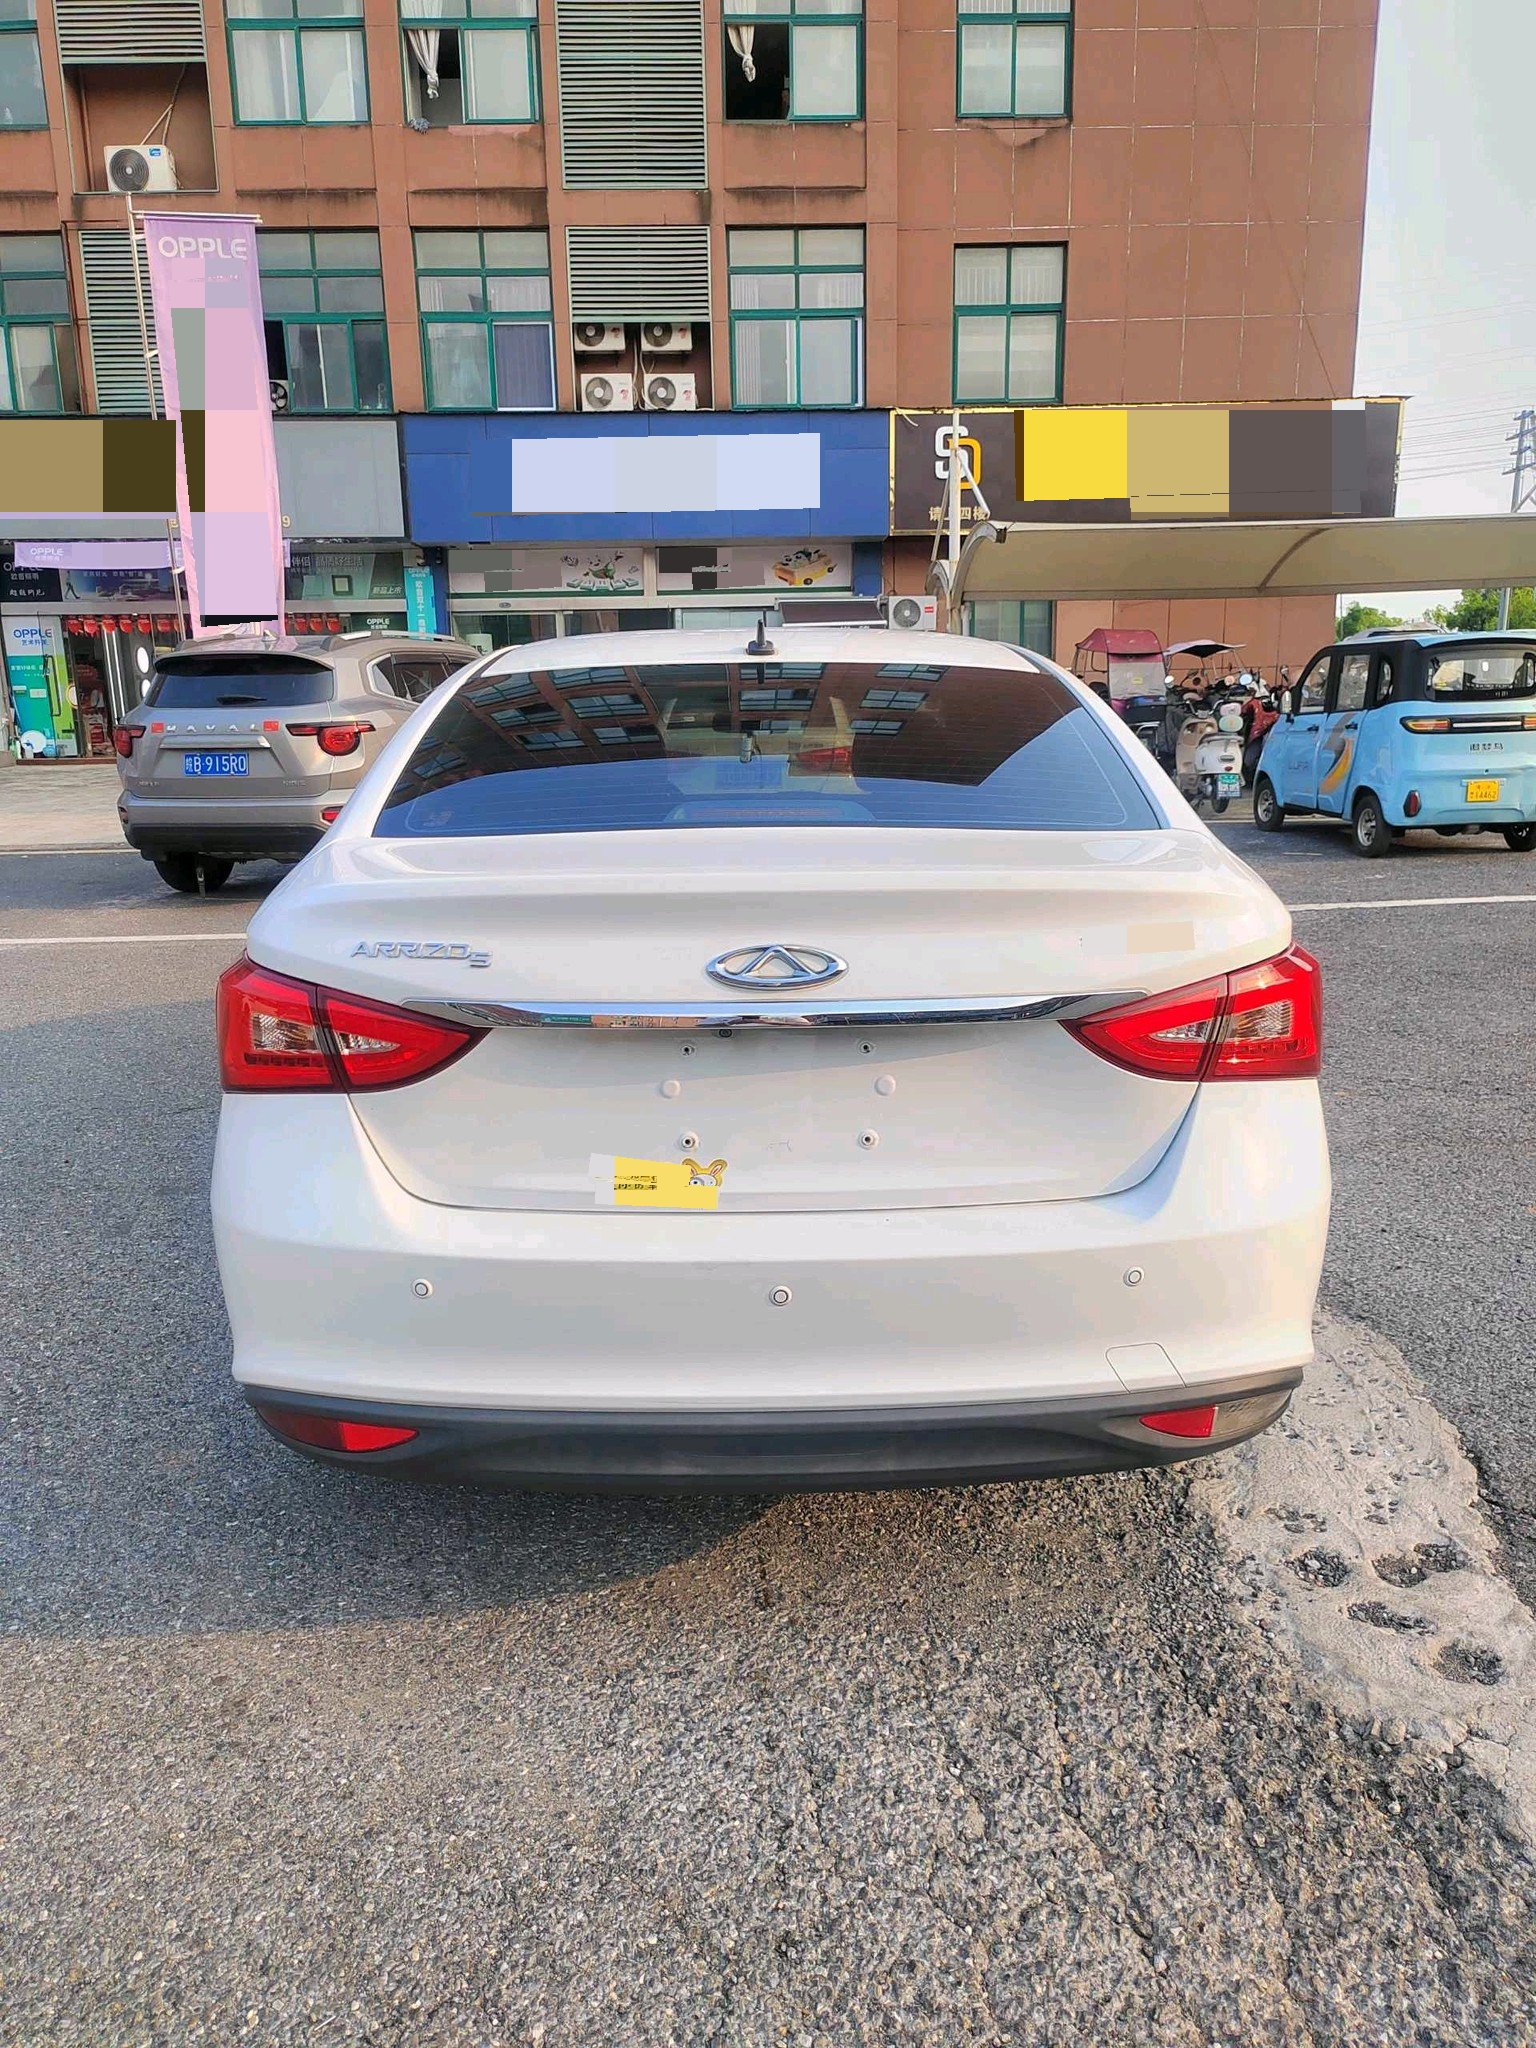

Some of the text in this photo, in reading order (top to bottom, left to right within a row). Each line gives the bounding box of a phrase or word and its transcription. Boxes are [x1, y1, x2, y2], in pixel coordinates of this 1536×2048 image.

[158, 236, 247, 259] OPPLE
[929, 505, 990, 521] 请四楼
[30, 547, 64, 556] OPPLE
[13, 628, 53, 639] OPPLE
